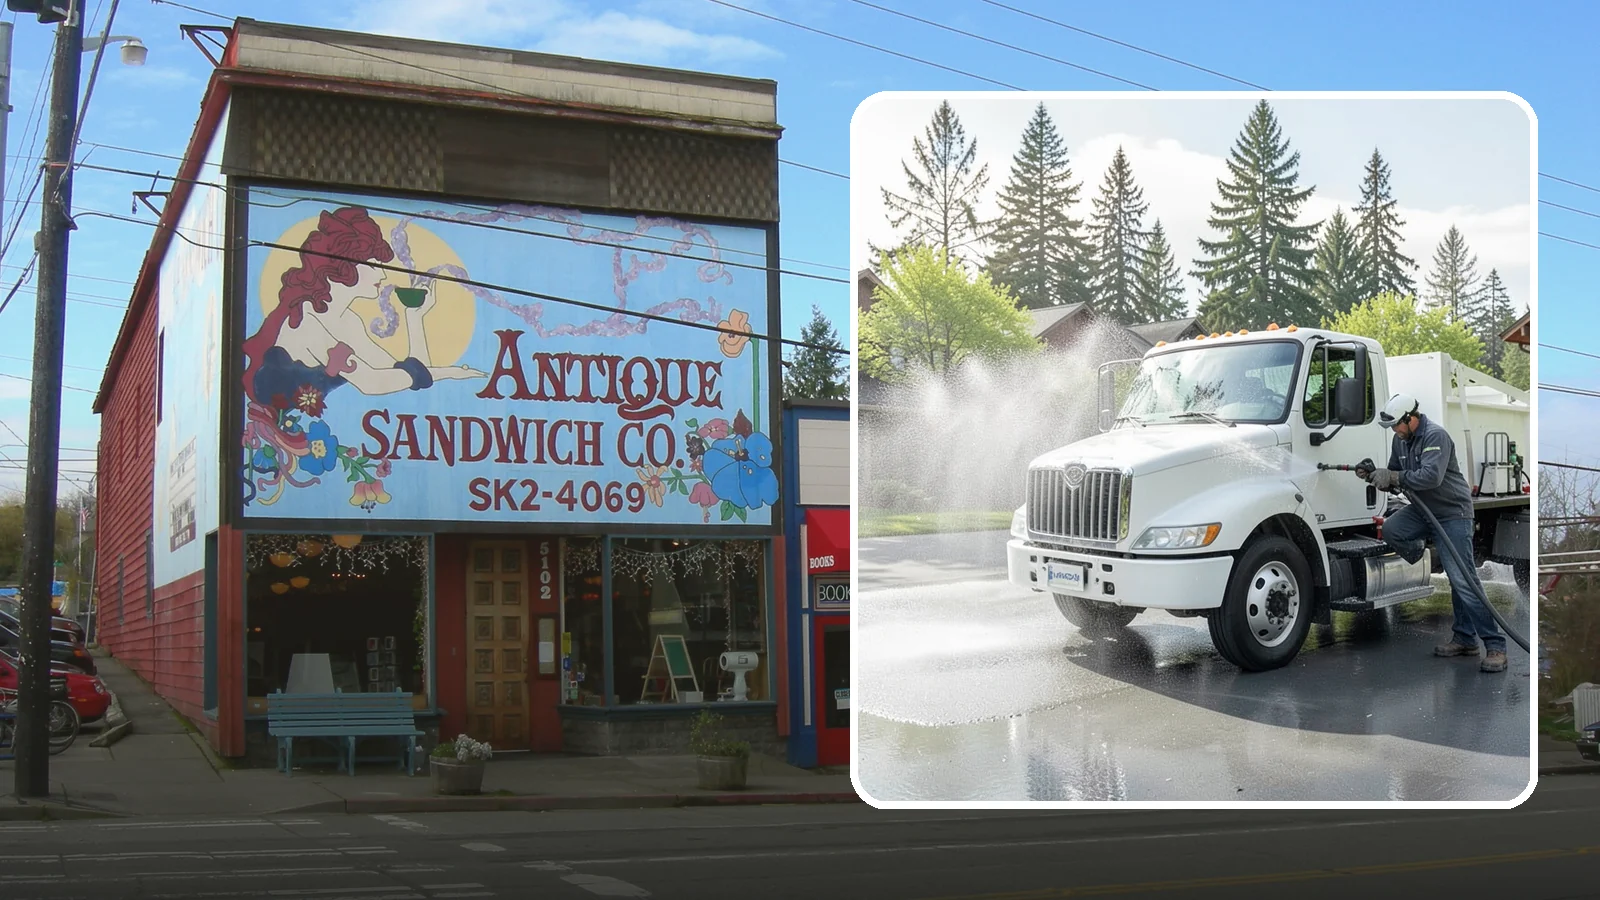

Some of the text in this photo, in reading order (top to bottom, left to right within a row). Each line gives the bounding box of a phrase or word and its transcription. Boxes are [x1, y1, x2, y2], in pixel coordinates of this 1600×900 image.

[476, 330, 724, 420] ANTIQUE
[361, 409, 685, 469] SANDWICH CO.
[468, 478, 646, 513] SK2-4069
[540, 541, 551, 600] 5102
[809, 555, 835, 569] BOOKS
